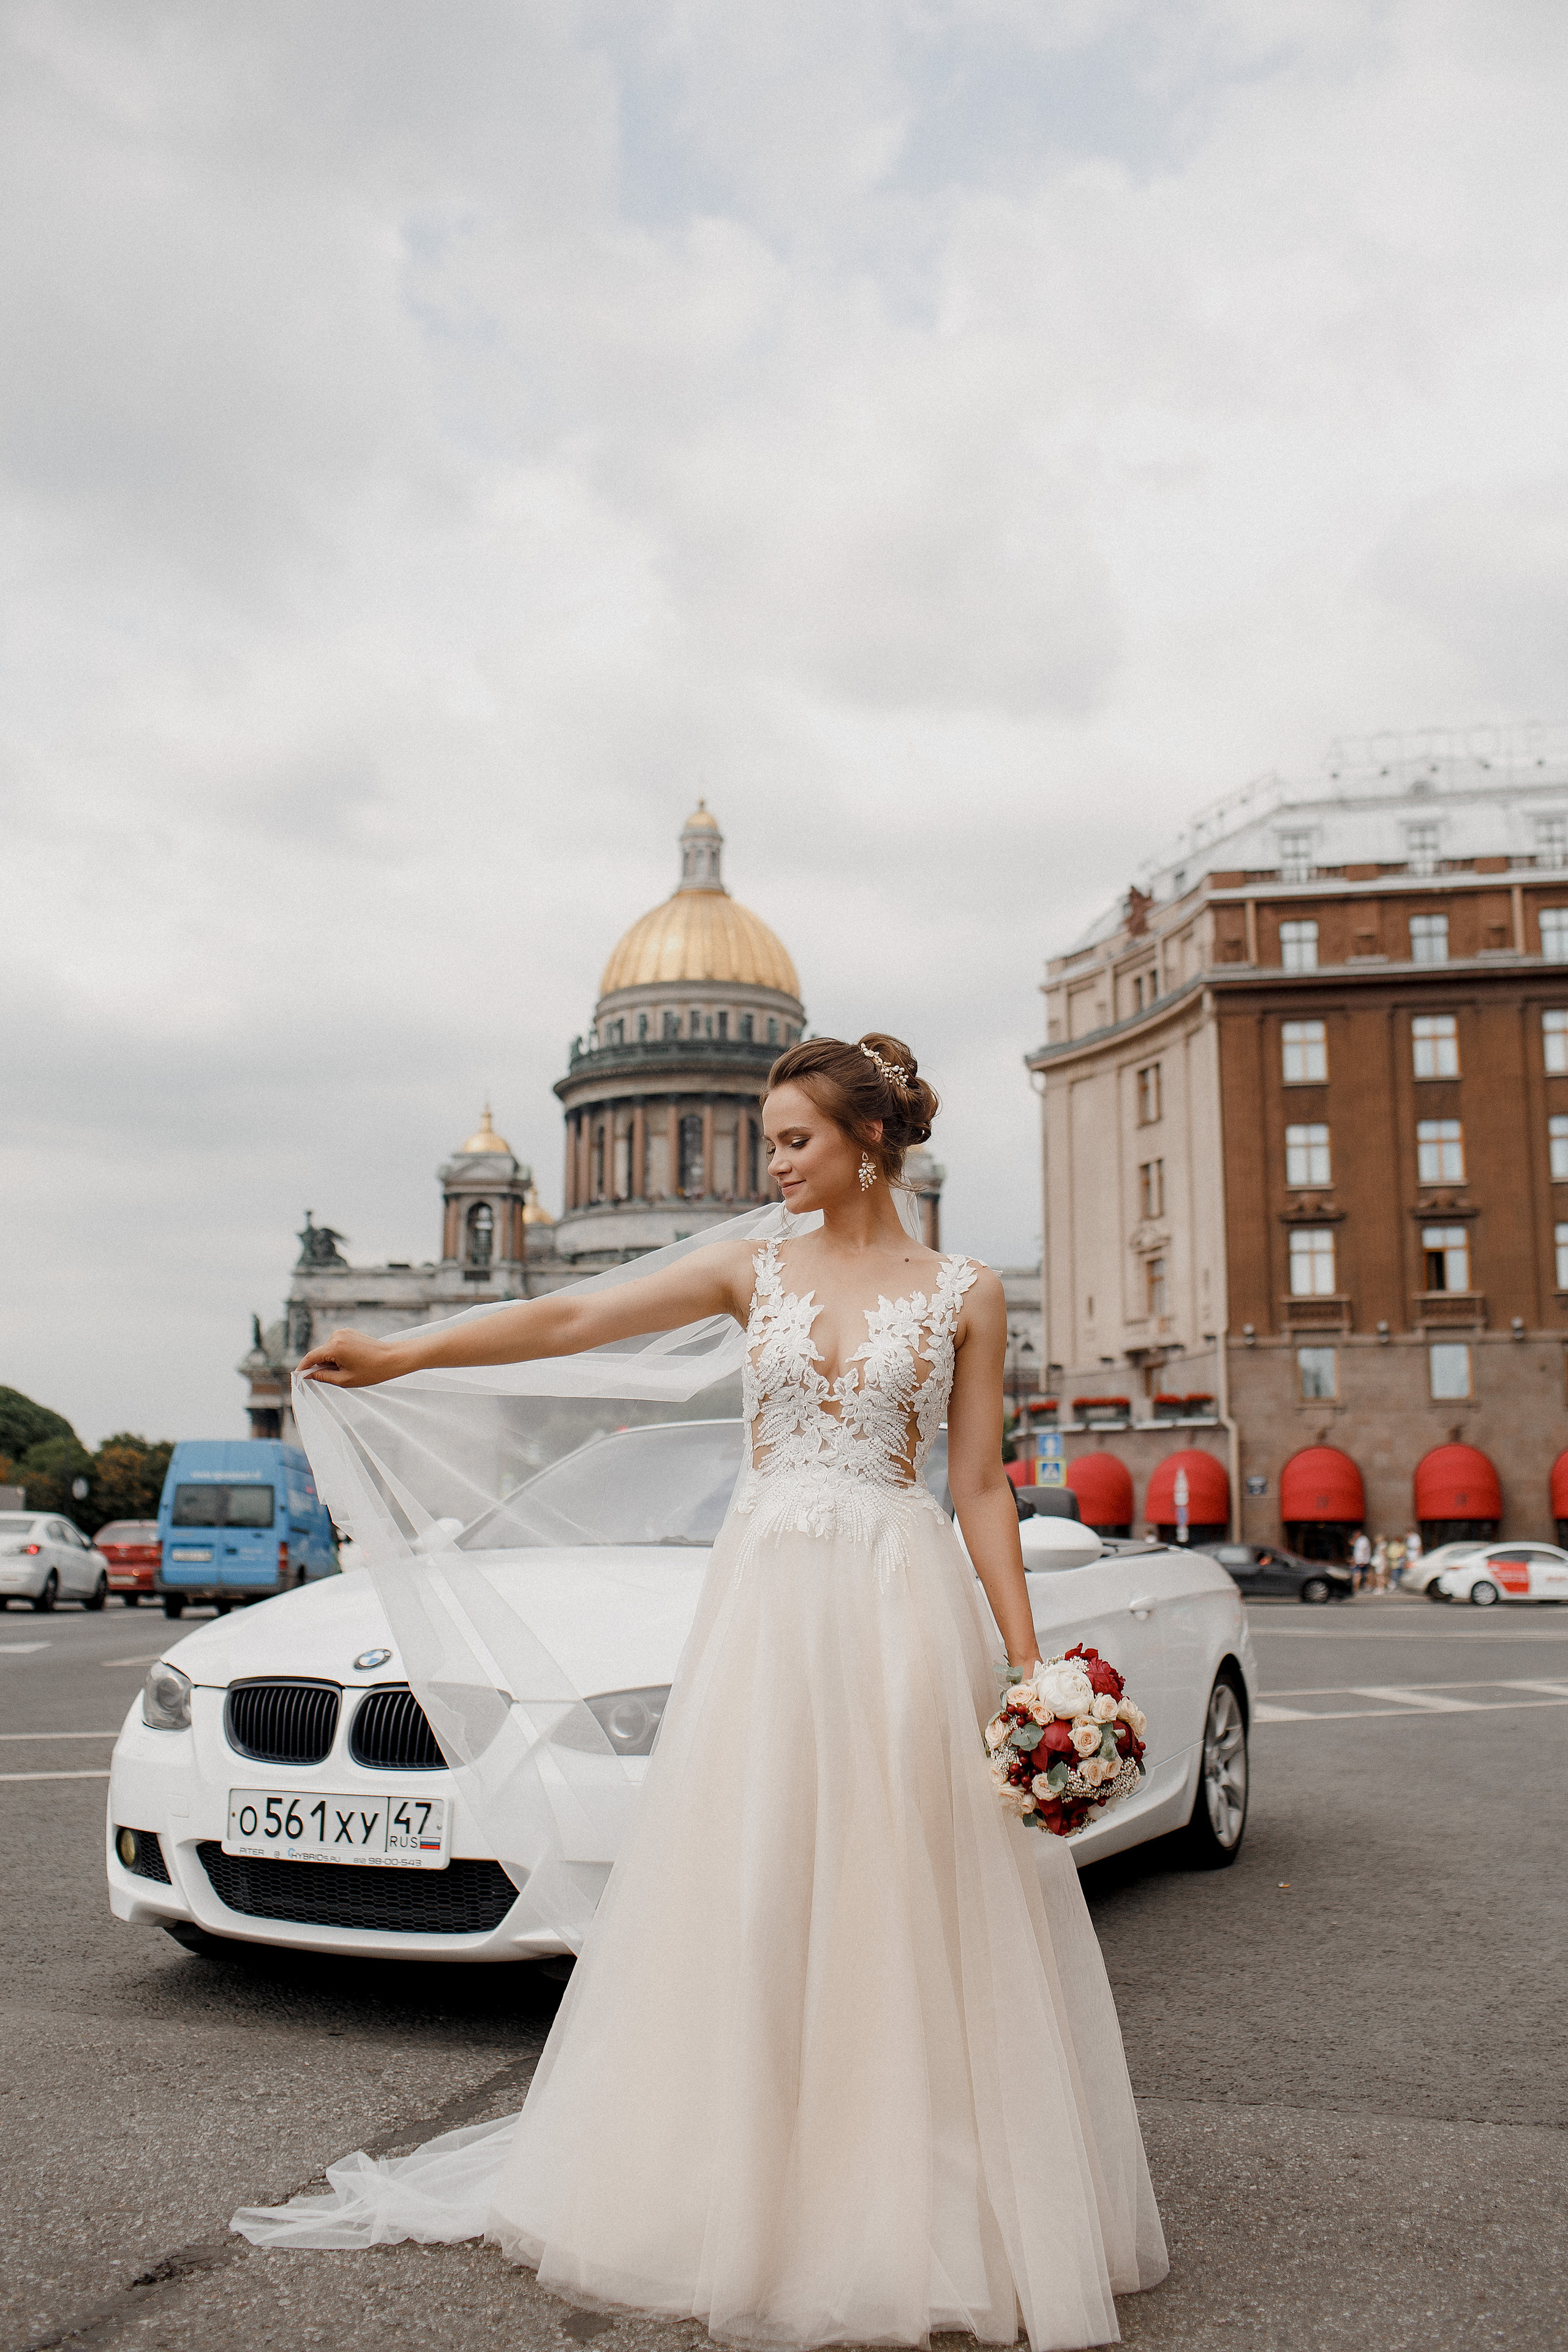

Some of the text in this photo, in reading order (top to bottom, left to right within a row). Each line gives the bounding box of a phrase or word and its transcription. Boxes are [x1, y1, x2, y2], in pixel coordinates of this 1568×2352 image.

[394, 1801, 431, 1834] 47
[390, 1836, 418, 1848] RUS
[239, 1847, 264, 1856] PITER
